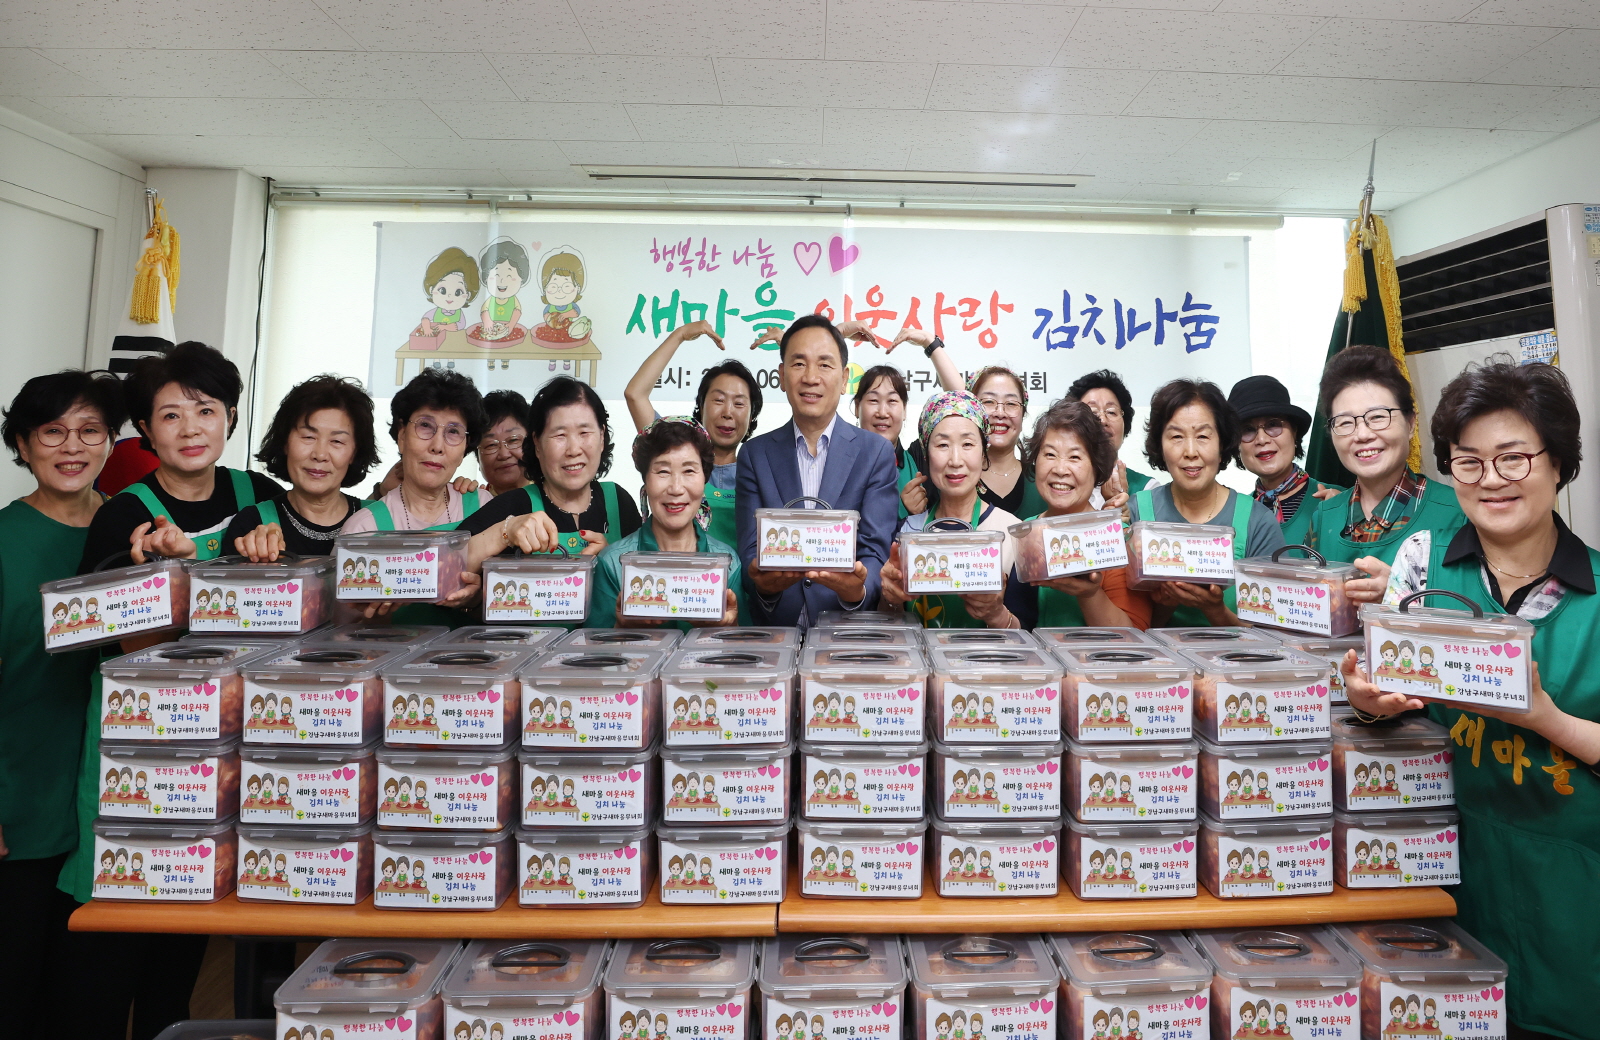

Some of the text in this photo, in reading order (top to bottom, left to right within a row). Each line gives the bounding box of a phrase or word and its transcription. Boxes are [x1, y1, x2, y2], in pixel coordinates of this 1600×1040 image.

[650, 237, 778, 279] 행복한 나눔
[625, 280, 1220, 354] 새마을 이웃사랑 김치나눔
[106, 588, 126, 598] 행복한
[107, 594, 160, 611] 새마을 이웃사랑
[121, 609, 135, 618] 김치
[1444, 644, 1489, 656] 행복한 나눔
[1444, 661, 1514, 676] 새마을 이웃사랑
[1462, 674, 1502, 686] 김치 나눔
[158, 688, 192, 696] 행복한 나눔
[1135, 691, 1153, 699] 행복한
[579, 696, 599, 704] 행복한
[157, 703, 210, 712] 새마을 이웃사랑
[1135, 705, 1184, 714] 새마을 이웃사랑
[170, 714, 200, 722] 김치 나눔
[579, 711, 632, 720] 새마을 이웃사랑
[1148, 716, 1160, 724] 김치
[593, 722, 622, 730] 김치 나눔
[297, 773, 331, 781] 행복한 나눔
[722, 771, 742, 779] 행복한
[723, 785, 774, 794] 새마을 이웃사랑
[1002, 782, 1053, 791] 새마을 이웃사랑
[296, 788, 349, 797] 새마을 이웃사랑
[1015, 792, 1044, 801] 김치 나눔
[310, 799, 339, 807] 김치 나눔
[736, 795, 766, 804] 김치 나눔
[1404, 837, 1436, 845] 행복한 나눔
[151, 849, 186, 857] 행복한 나눔
[1139, 847, 1158, 855] 행복한
[1404, 851, 1452, 860] 새마을 이웃사랑
[433, 856, 468, 865] 행복한 나눔
[151, 864, 204, 873] 새마을 이웃사랑
[1139, 861, 1189, 870] 새마을 이웃사랑
[1417, 861, 1444, 870] 김치 나눔
[164, 875, 194, 883] 김치 나눔
[432, 872, 485, 881] 새마을 이웃사랑
[1152, 871, 1181, 880] 김치 나눔
[446, 883, 476, 891] 김치 나눔
[1444, 994, 1480, 1002] 행복한 나눔
[1295, 999, 1332, 1008] 행복한 나눔
[677, 1009, 715, 1017] 행복한 나눔
[991, 1006, 1028, 1016] 행복한 나눔
[1444, 1010, 1498, 1020] 새마을 이웃사랑
[1296, 1016, 1351, 1026] 새마을 이웃사랑
[343, 1023, 384, 1033] 행복한 나눔
[676, 1025, 735, 1035] 새마을 이웃사랑
[992, 1021, 1047, 1033] 새마을 이웃사랑
[1458, 1021, 1489, 1031] 김치 나눔
[1310, 1028, 1342, 1037] 김치 나눔
